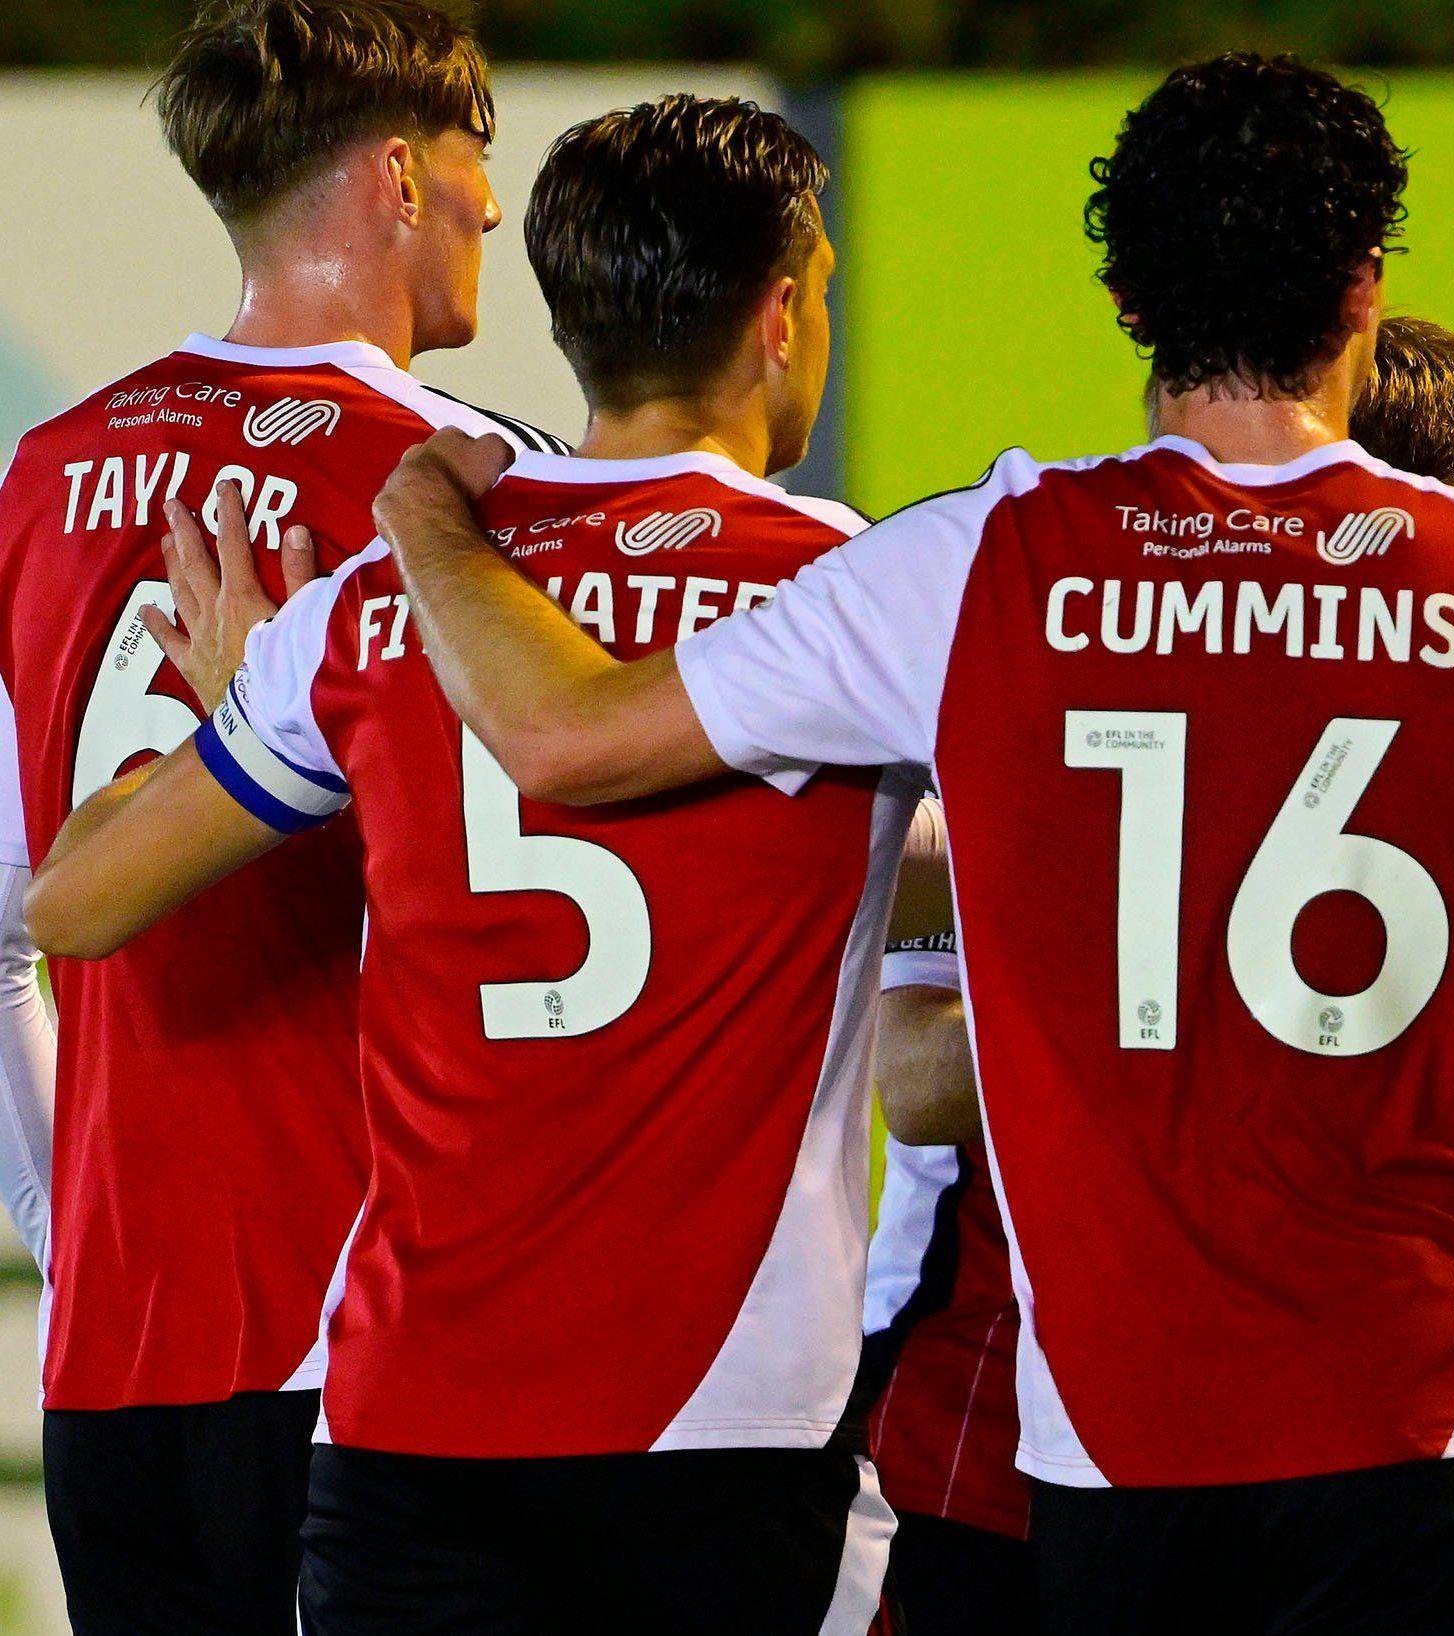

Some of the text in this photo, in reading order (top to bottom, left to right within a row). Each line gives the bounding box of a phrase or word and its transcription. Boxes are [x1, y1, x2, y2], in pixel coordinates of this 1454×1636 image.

[105, 382, 242, 410] Taking Care
[108, 408, 203, 430] Personal Alarms
[64, 451, 298, 550] TAYLOR
[1115, 506, 1305, 540] Taking Care
[511, 536, 563, 558] Alarms
[1143, 539, 1272, 558] Personal Alarms
[119, 634, 133, 651] EFL
[1105, 740, 1165, 750] COMMUNITY
[461, 721, 652, 1039] 5
[1064, 710, 1449, 1057] 16
[547, 1017, 566, 1030] EFL
[1140, 1028, 1160, 1039] EFL
[1319, 1035, 1340, 1046] EFL
